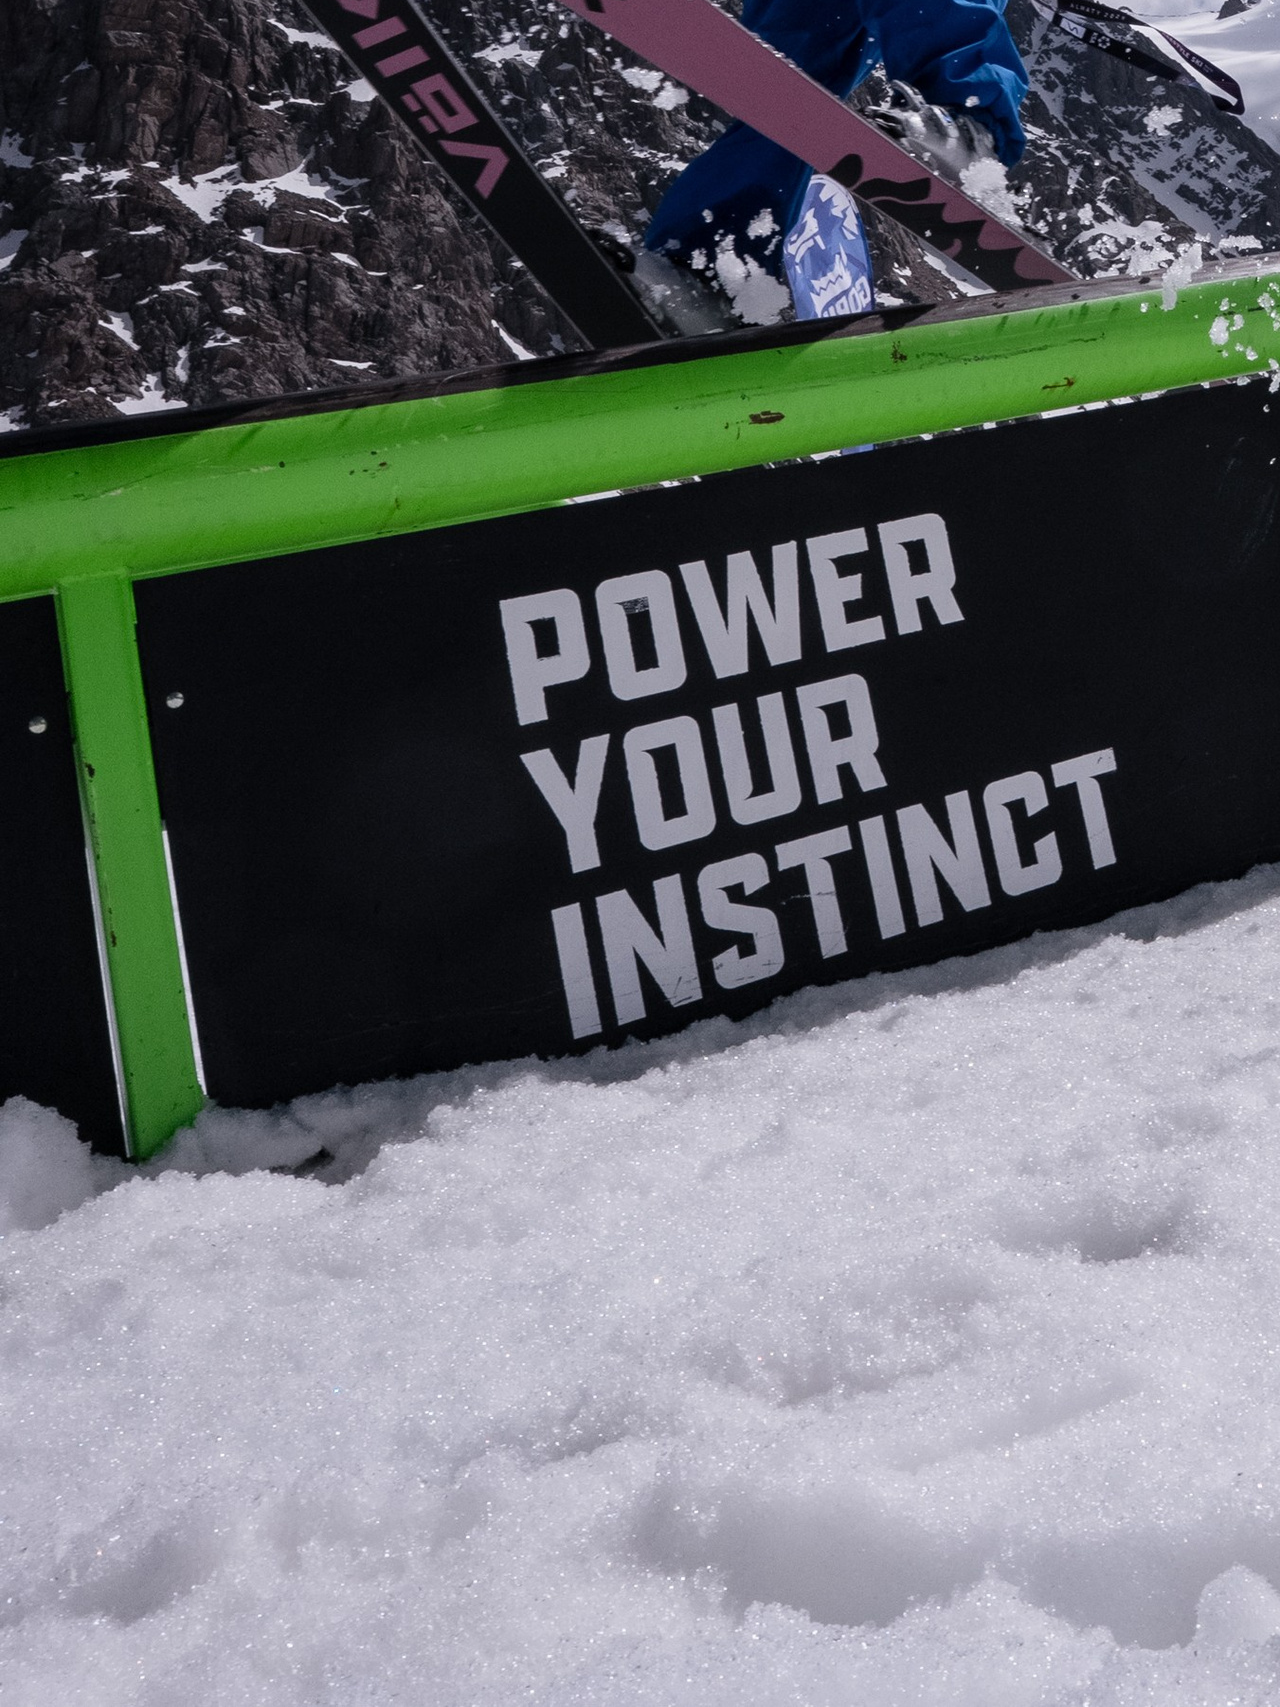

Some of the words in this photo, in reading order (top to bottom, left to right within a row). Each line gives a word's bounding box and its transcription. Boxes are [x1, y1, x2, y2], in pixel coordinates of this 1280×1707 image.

[1069, 2, 1102, 16] ALMATY
[1190, 56, 1204, 68] SKI
[499, 513, 966, 726] POWER
[519, 673, 889, 874] YOUR
[550, 747, 1118, 1040] INSTINCT
